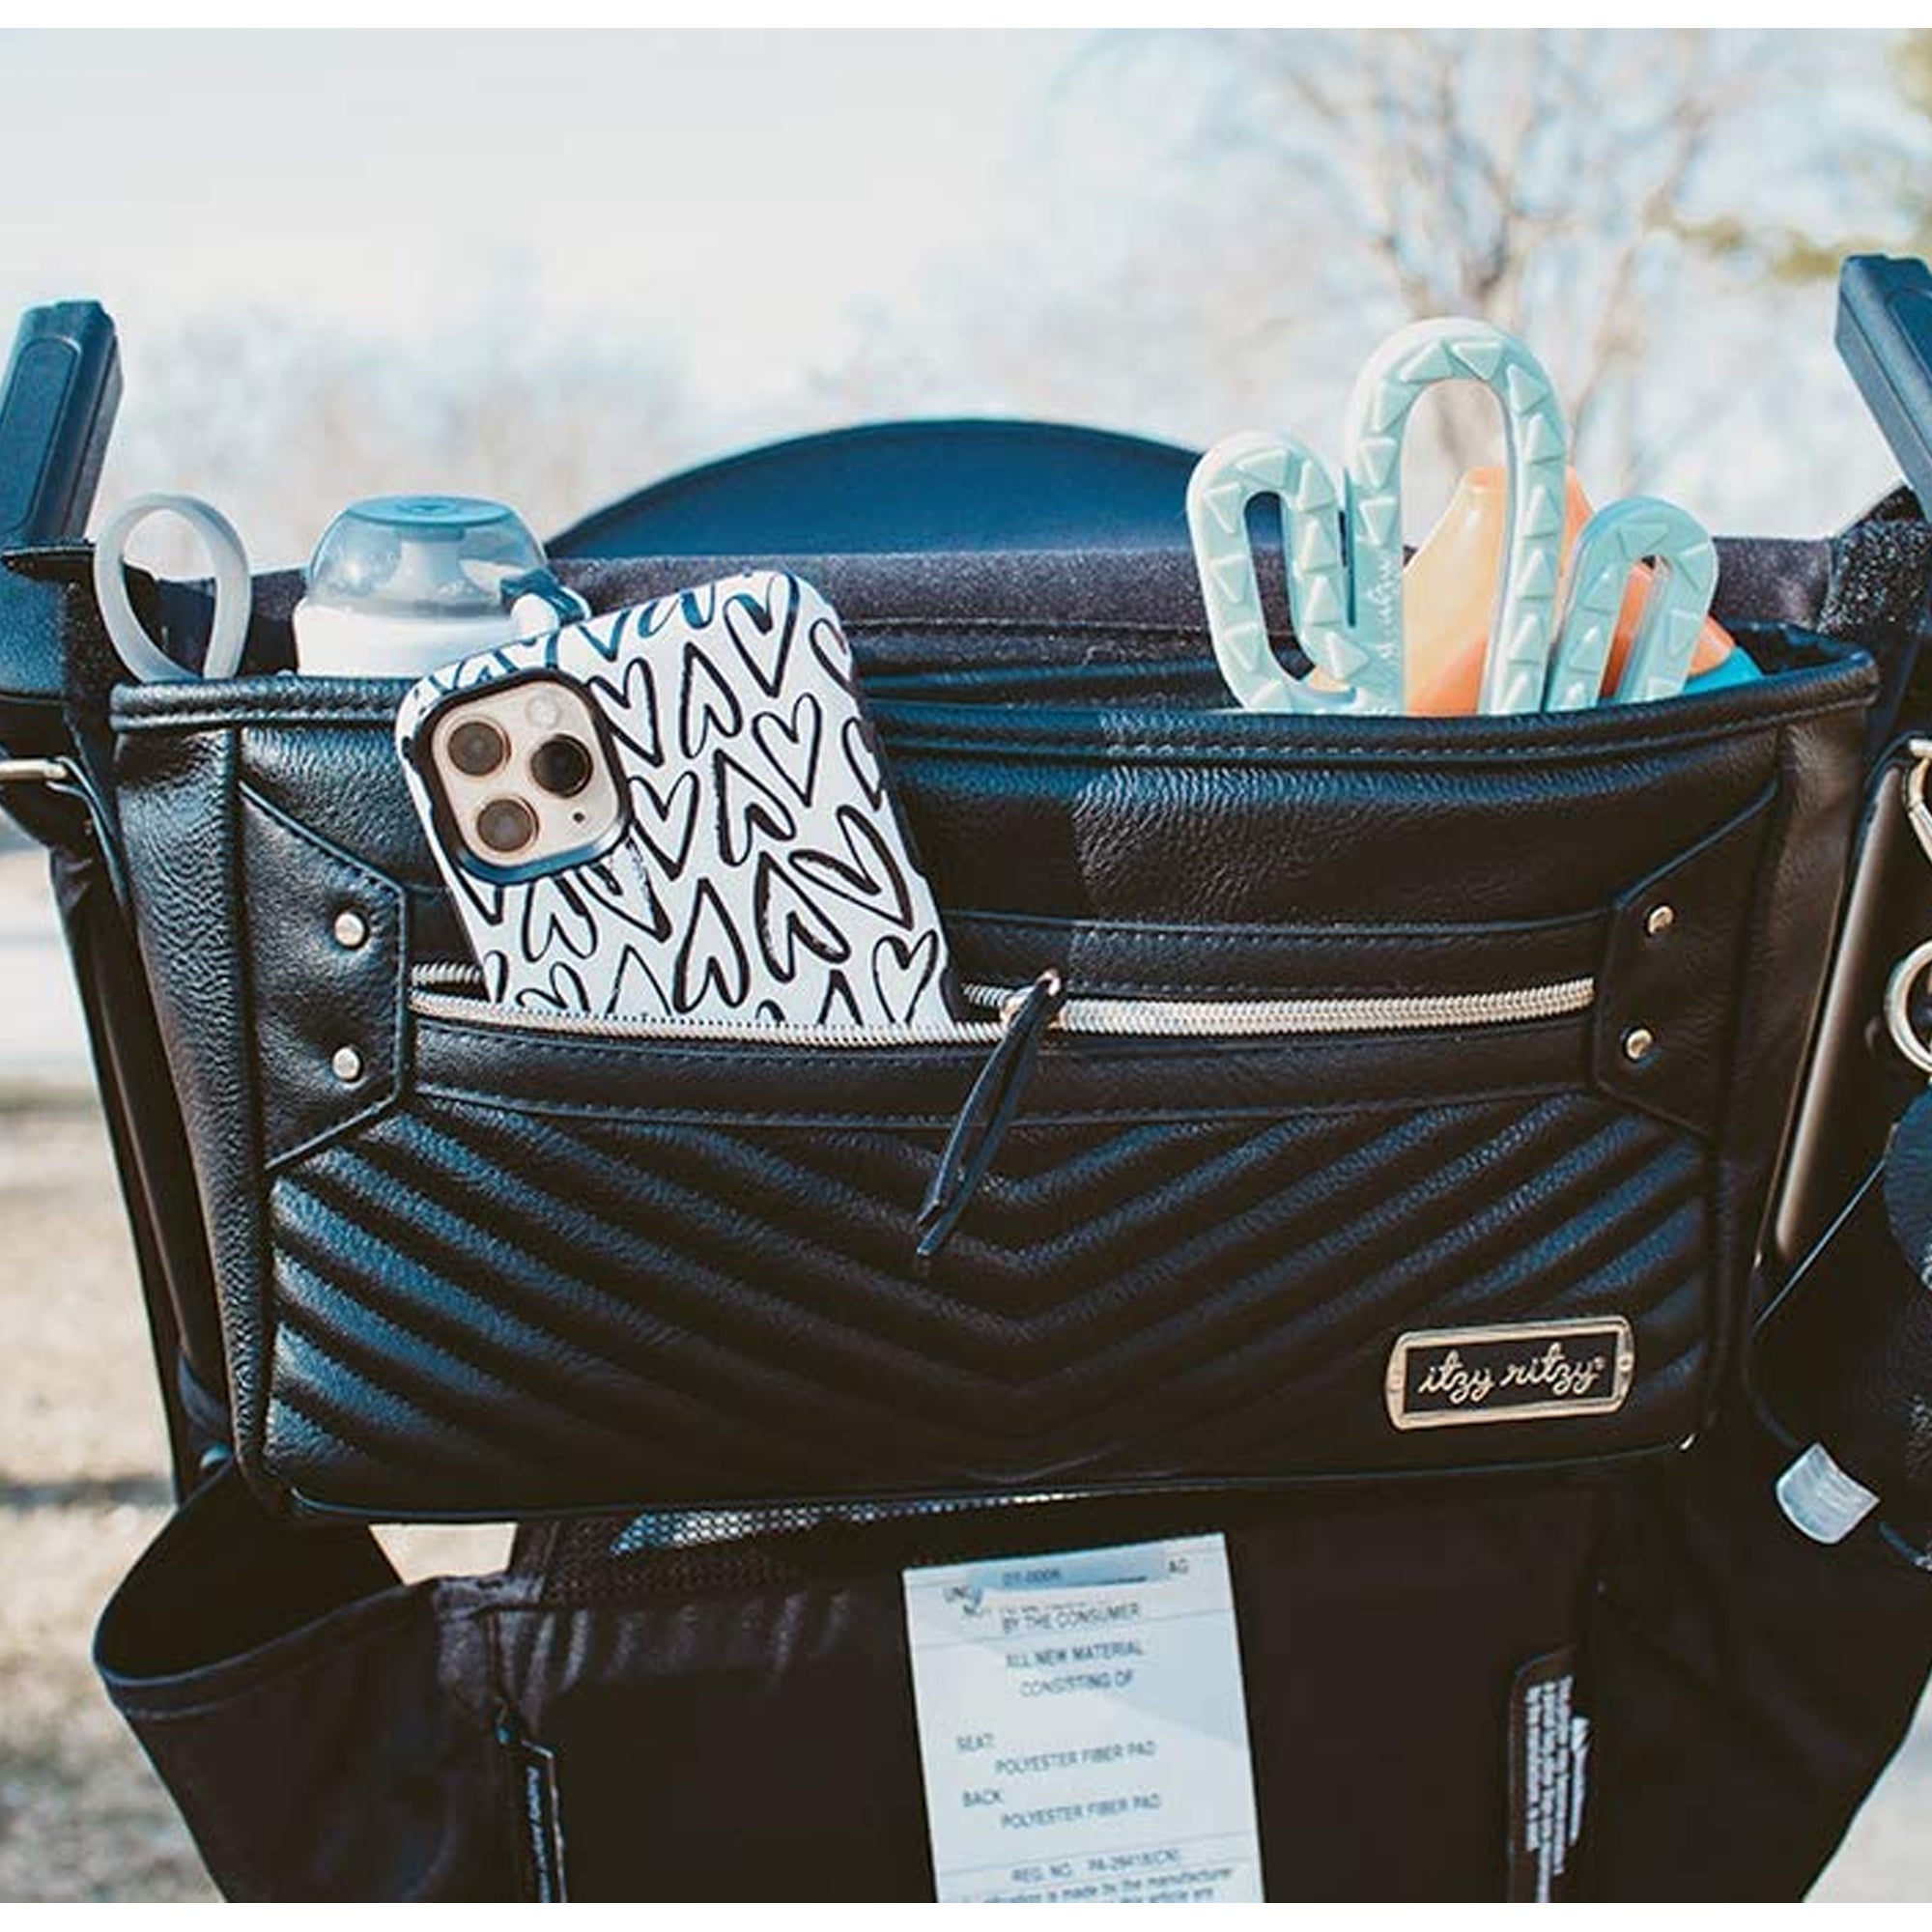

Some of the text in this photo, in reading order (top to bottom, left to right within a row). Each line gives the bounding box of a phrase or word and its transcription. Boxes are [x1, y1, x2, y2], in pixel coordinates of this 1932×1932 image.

[1417, 1350, 1494, 1405] itzy
[1023, 1610, 1053, 1632] THE
[1055, 1602, 1140, 1630] CONSUMER
[1034, 1648, 1068, 1668] NEW
[1070, 1641, 1145, 1662] MATERIAL
[1019, 1672, 1111, 1699] CONSISTING
[995, 1740, 1158, 1776] POLYESTER FIBER PAD
[1000, 1793, 1162, 1830] POLYESTER FIBER PAD
